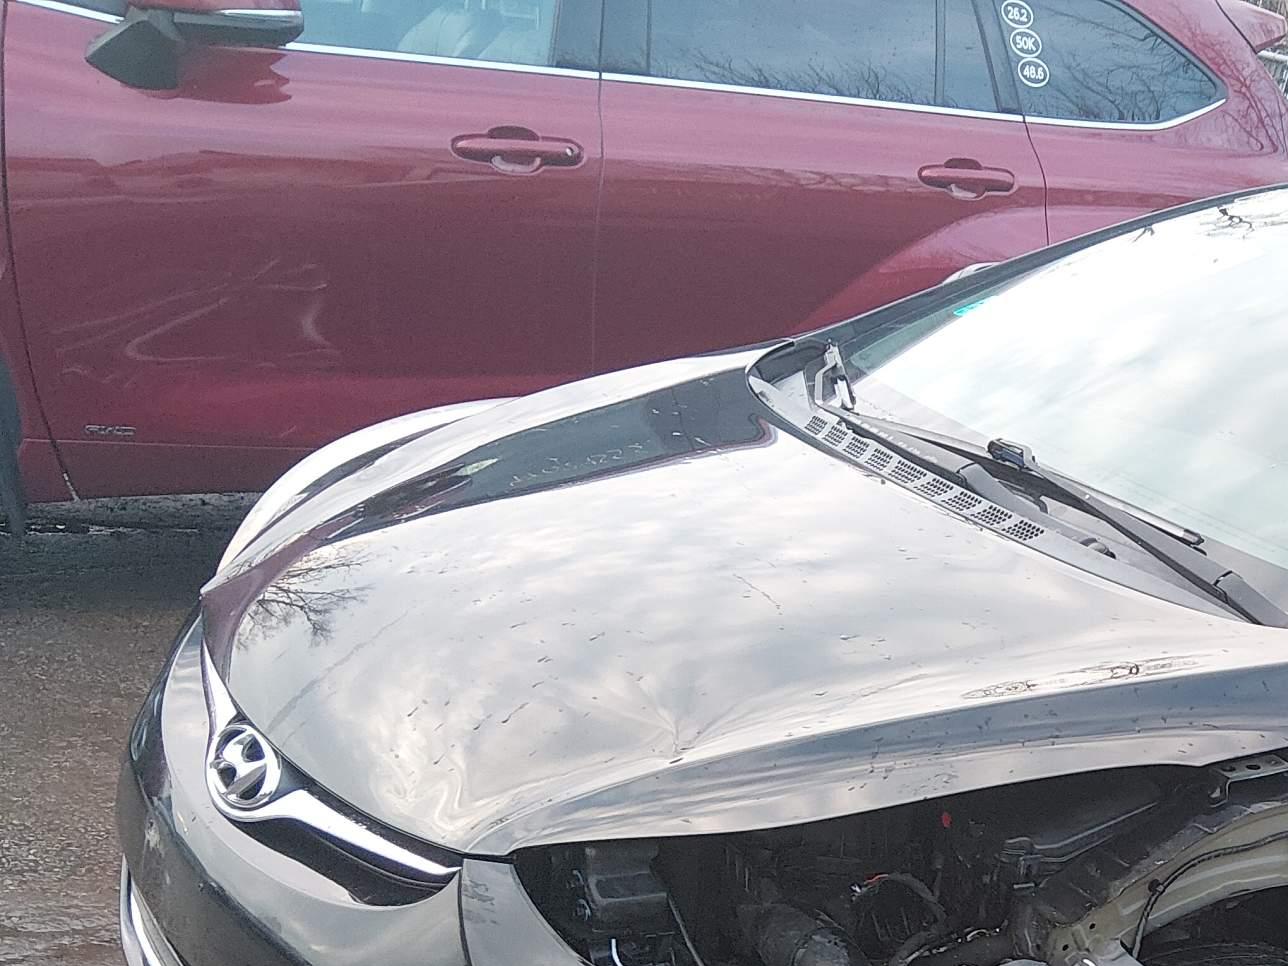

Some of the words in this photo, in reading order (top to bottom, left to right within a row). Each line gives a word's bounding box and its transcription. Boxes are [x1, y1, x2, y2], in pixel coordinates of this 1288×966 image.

[1007, 6, 1028, 22] 26.2
[1015, 35, 1037, 51] 50K
[1023, 64, 1045, 80] 48.6
